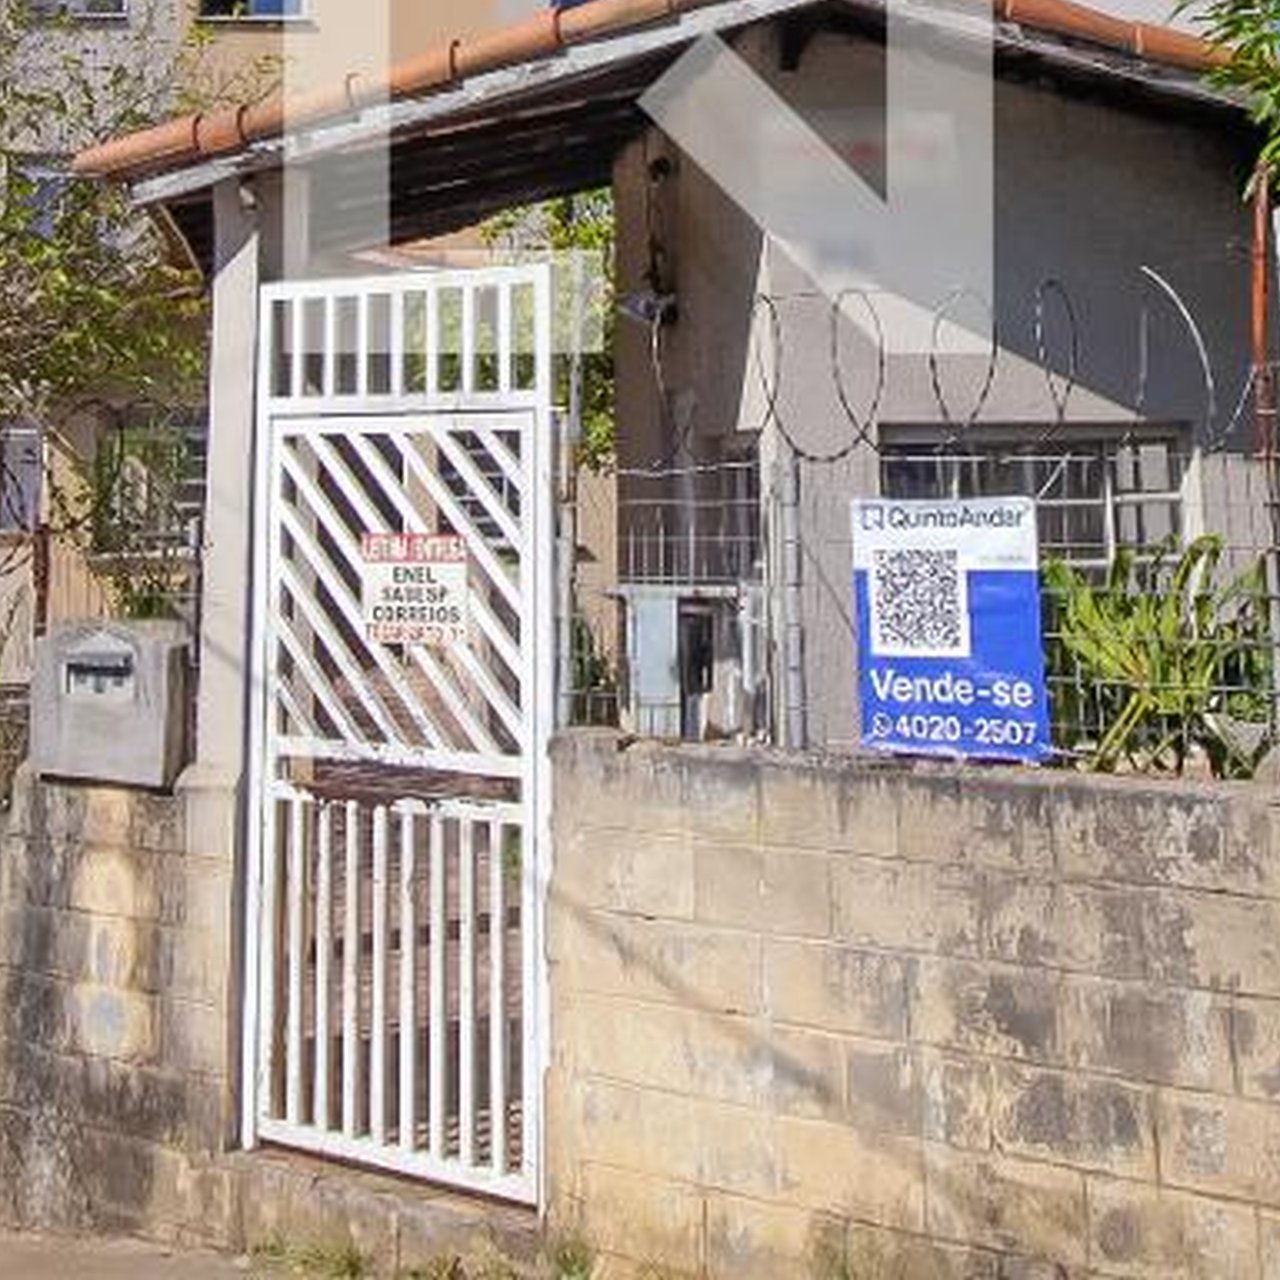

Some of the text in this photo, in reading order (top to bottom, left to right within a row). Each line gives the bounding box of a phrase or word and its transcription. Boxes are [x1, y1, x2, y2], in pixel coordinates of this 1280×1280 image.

[889, 505, 1022, 531] QuintoAndar
[392, 566, 437, 583] ENEL
[372, 606, 461, 623] CORREIOS
[870, 669, 1034, 707] Vende-se
